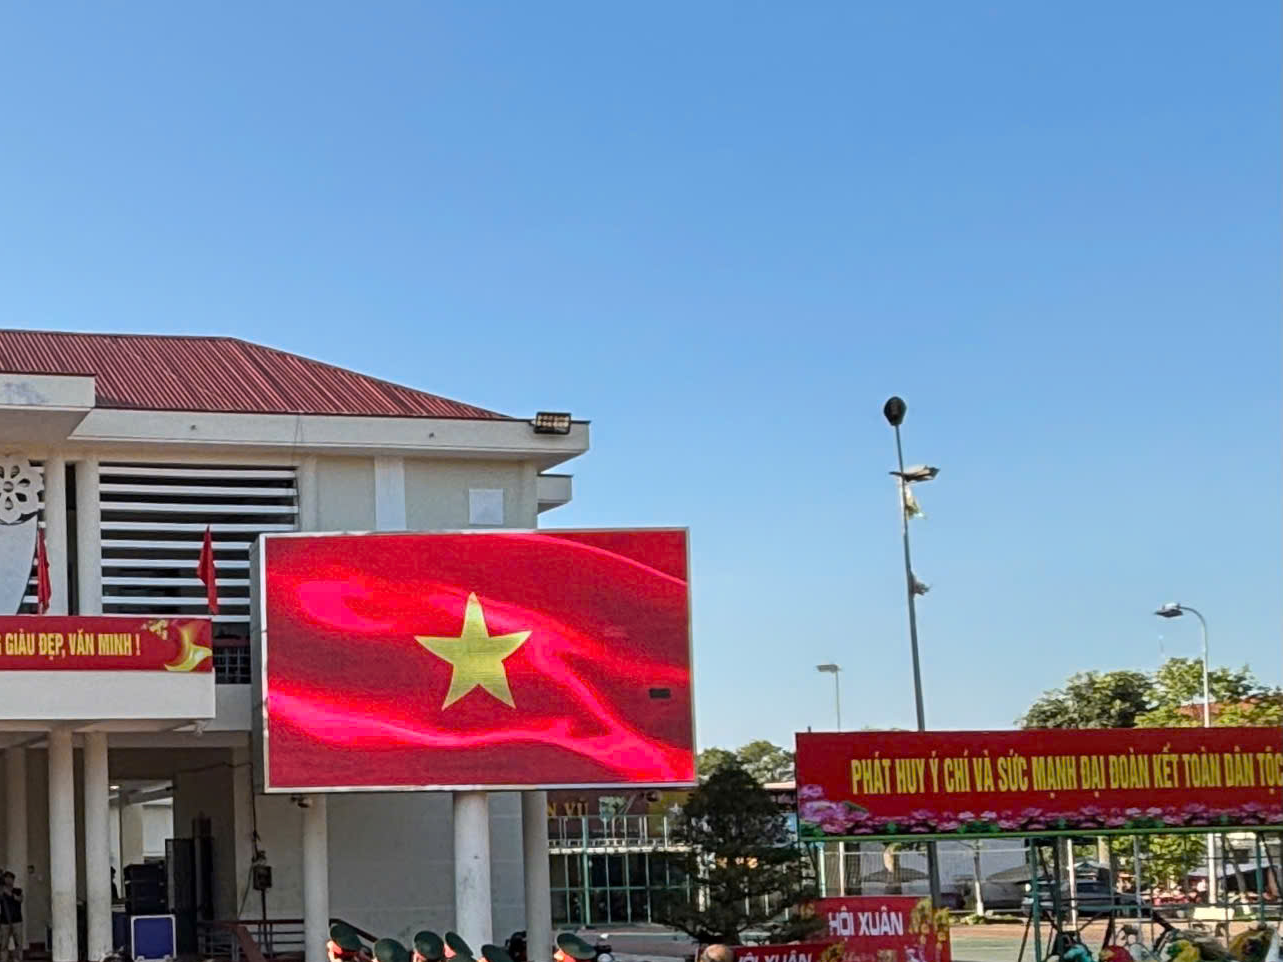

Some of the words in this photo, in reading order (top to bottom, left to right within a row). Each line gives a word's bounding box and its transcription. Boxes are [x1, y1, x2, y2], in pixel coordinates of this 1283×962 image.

[5, 628, 35, 656] GIÀU
[38, 632, 66, 660] ĐẸP,
[68, 628, 95, 656] VĂN
[98, 632, 133, 656] MINH
[135, 632, 142, 656] !
[851, 751, 892, 794] PHÁT
[894, 757, 926, 793] HUY
[929, 751, 940, 793] Ý
[943, 750, 971, 793] CHÍ
[973, 750, 995, 793] VÀ
[997, 749, 1029, 792] SỨC
[1031, 755, 1078, 799] MẠNH
[1080, 754, 1106, 798] ĐẠI
[1108, 747, 1150, 788] ĐOÀN
[1152, 742, 1180, 788] KẾT
[1182, 746, 1222, 787] TOÀN
[1223, 745, 1255, 787] DÂN
[829, 905, 855, 942] HỘI
[858, 905, 904, 936] XUÂN
